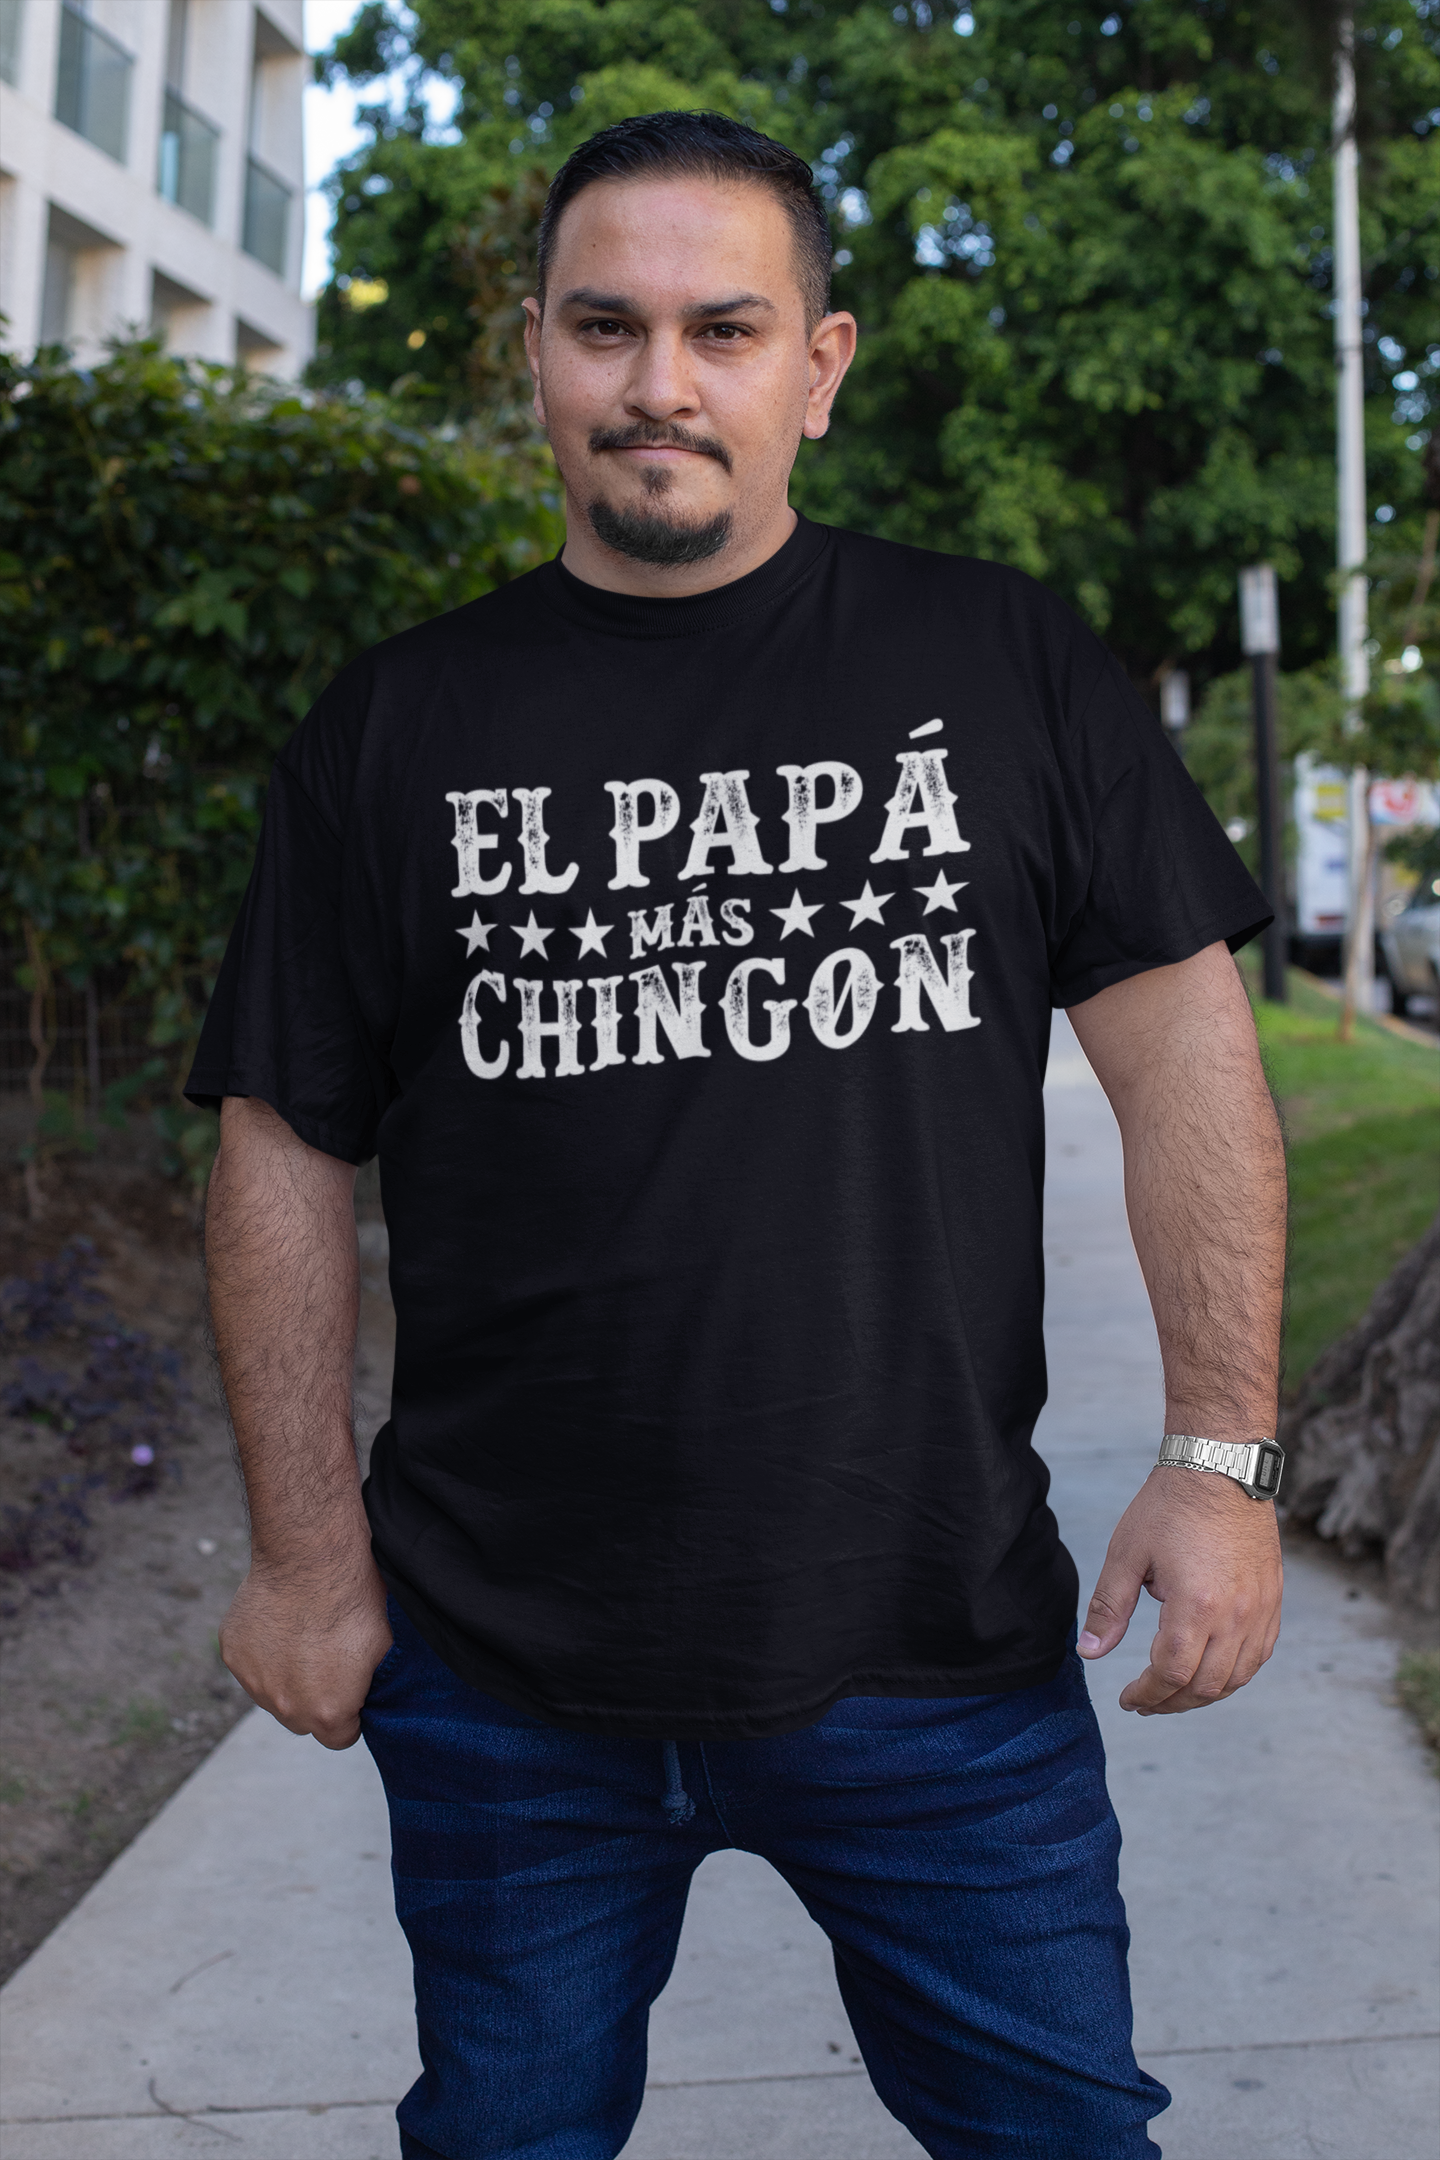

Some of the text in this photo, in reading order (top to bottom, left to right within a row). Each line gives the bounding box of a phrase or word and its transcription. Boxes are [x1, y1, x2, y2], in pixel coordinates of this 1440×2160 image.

[445, 717, 972, 898] EL PAPÁ
[627, 882, 755, 960] MÁS
